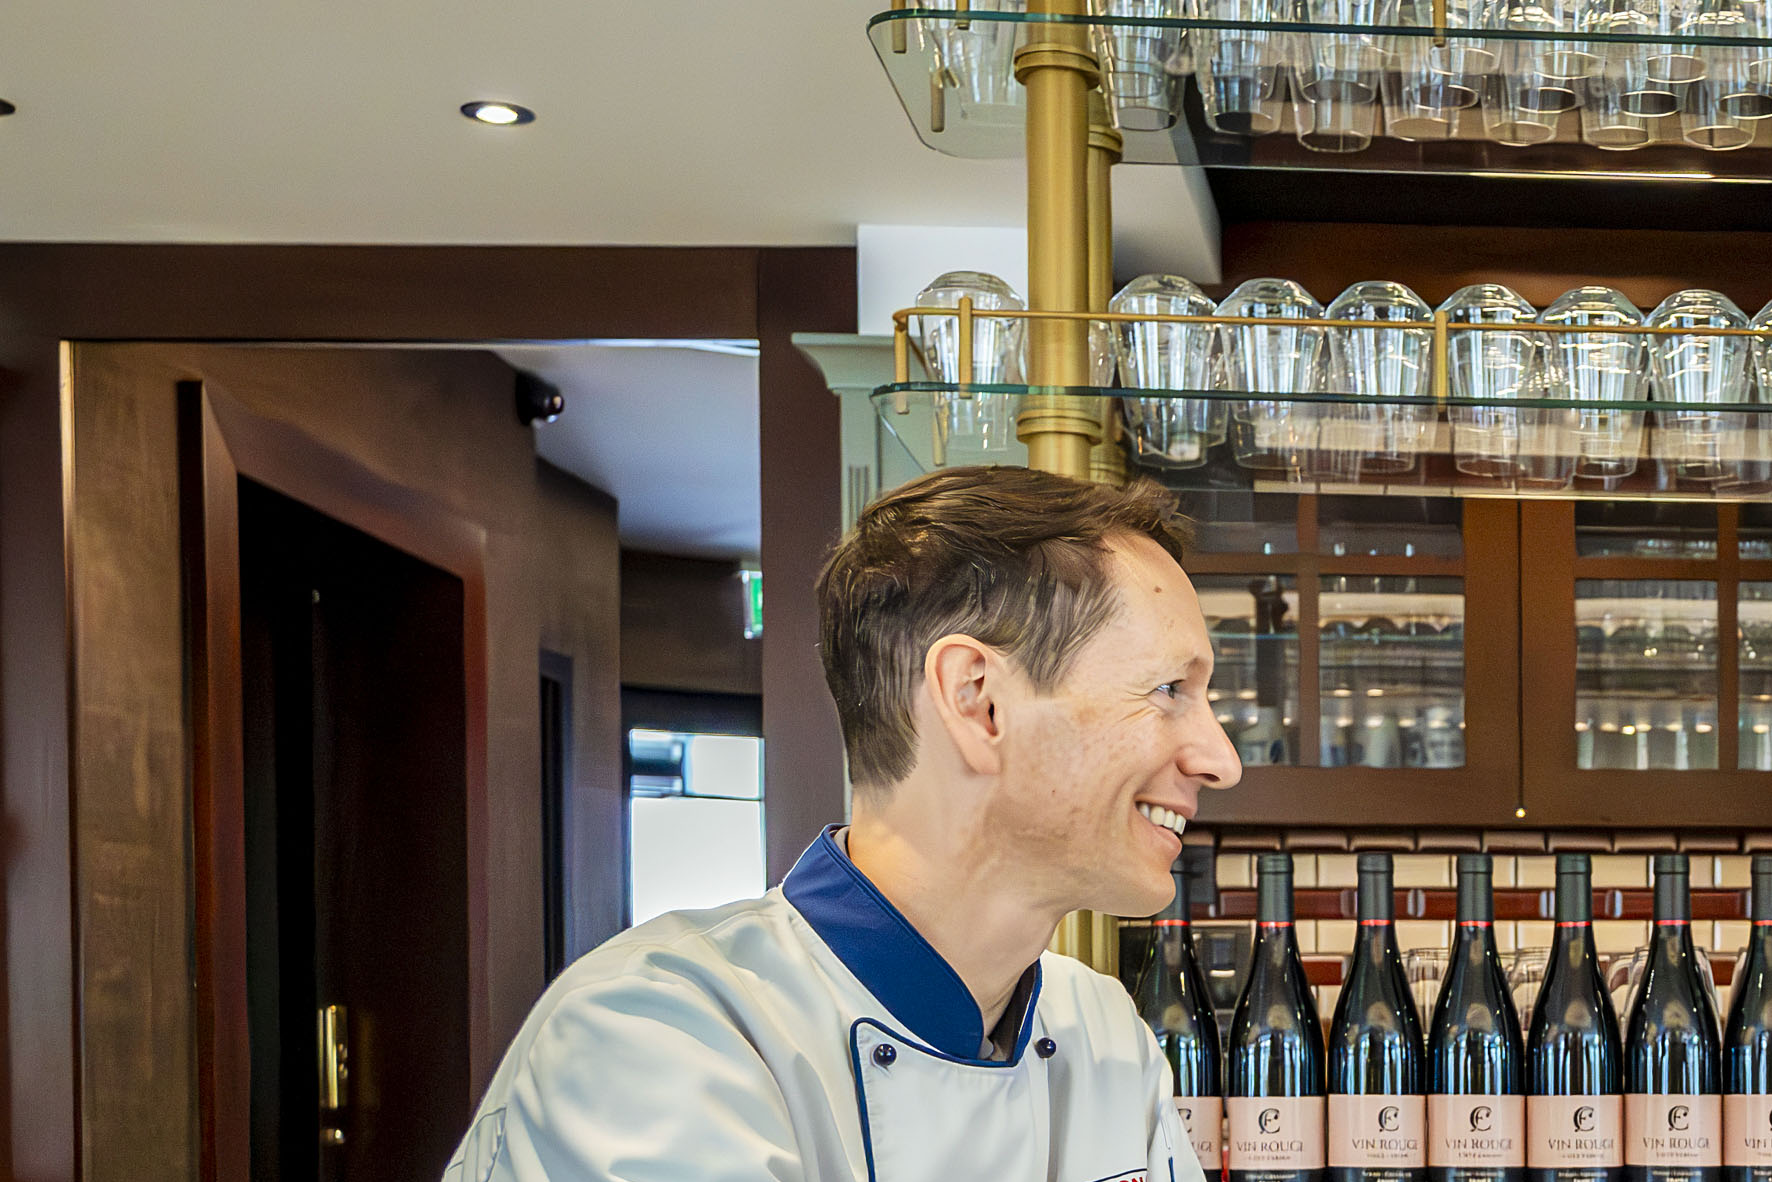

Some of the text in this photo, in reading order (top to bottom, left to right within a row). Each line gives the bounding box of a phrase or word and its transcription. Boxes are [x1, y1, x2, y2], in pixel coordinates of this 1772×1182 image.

[1236, 1141, 1256, 1153] VIN
[1352, 1138, 1375, 1150] VIN
[1445, 1138, 1467, 1150] VIN
[1548, 1138, 1571, 1150] VIN
[1643, 1137, 1665, 1149] VIN
[1744, 1137, 1766, 1149] VIN
